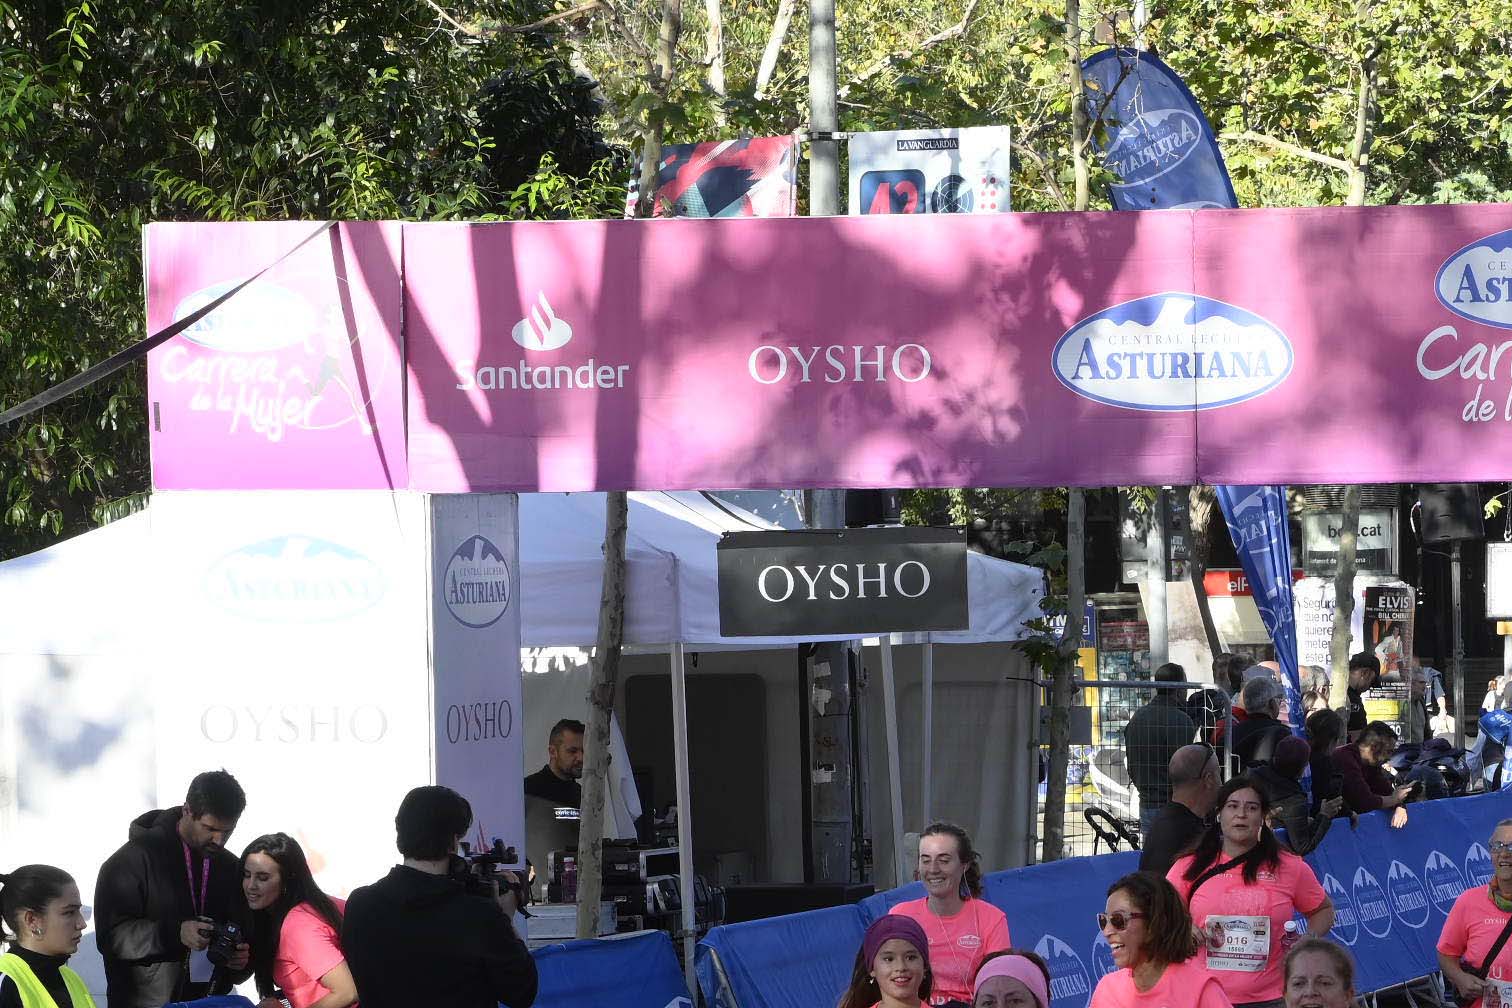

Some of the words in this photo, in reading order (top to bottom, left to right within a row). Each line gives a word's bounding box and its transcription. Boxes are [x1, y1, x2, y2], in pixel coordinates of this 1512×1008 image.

[456, 358, 629, 390] Santander
[748, 344, 931, 384] OYSHO
[1071, 338, 1273, 380] ASTURIANA
[1462, 384, 1497, 422] de
[449, 570, 507, 605] ASTURIANA
[758, 561, 932, 603] OYSHO
[1378, 596, 1410, 609] ELVIS
[200, 705, 390, 744] OYSHO
[446, 699, 513, 744] OYSHO
[1226, 935, 1249, 945] 016
